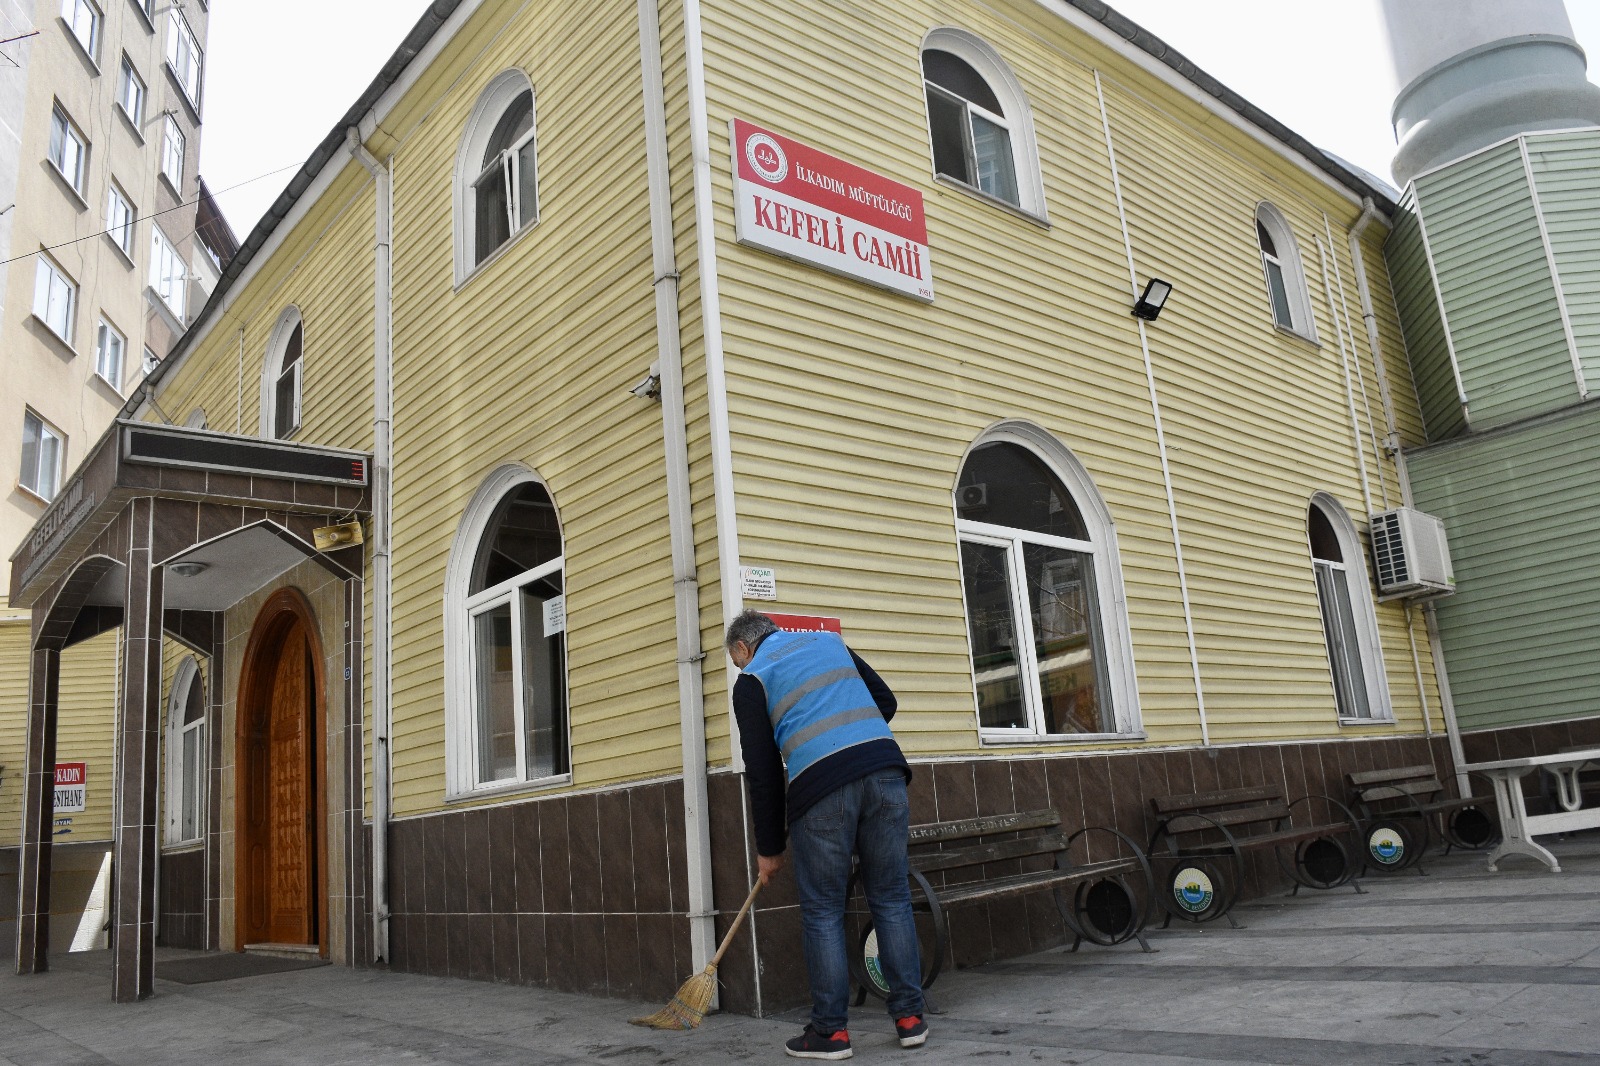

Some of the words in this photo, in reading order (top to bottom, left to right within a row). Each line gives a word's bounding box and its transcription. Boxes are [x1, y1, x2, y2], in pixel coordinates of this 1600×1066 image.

[796, 162, 845, 196] İLKADIM
[849, 185, 913, 222] MÜFTÜLÜĞÜ
[753, 195, 846, 255] KEFELİ
[853, 231, 923, 281] CAMİİ
[57, 768, 80, 782] KADIN
